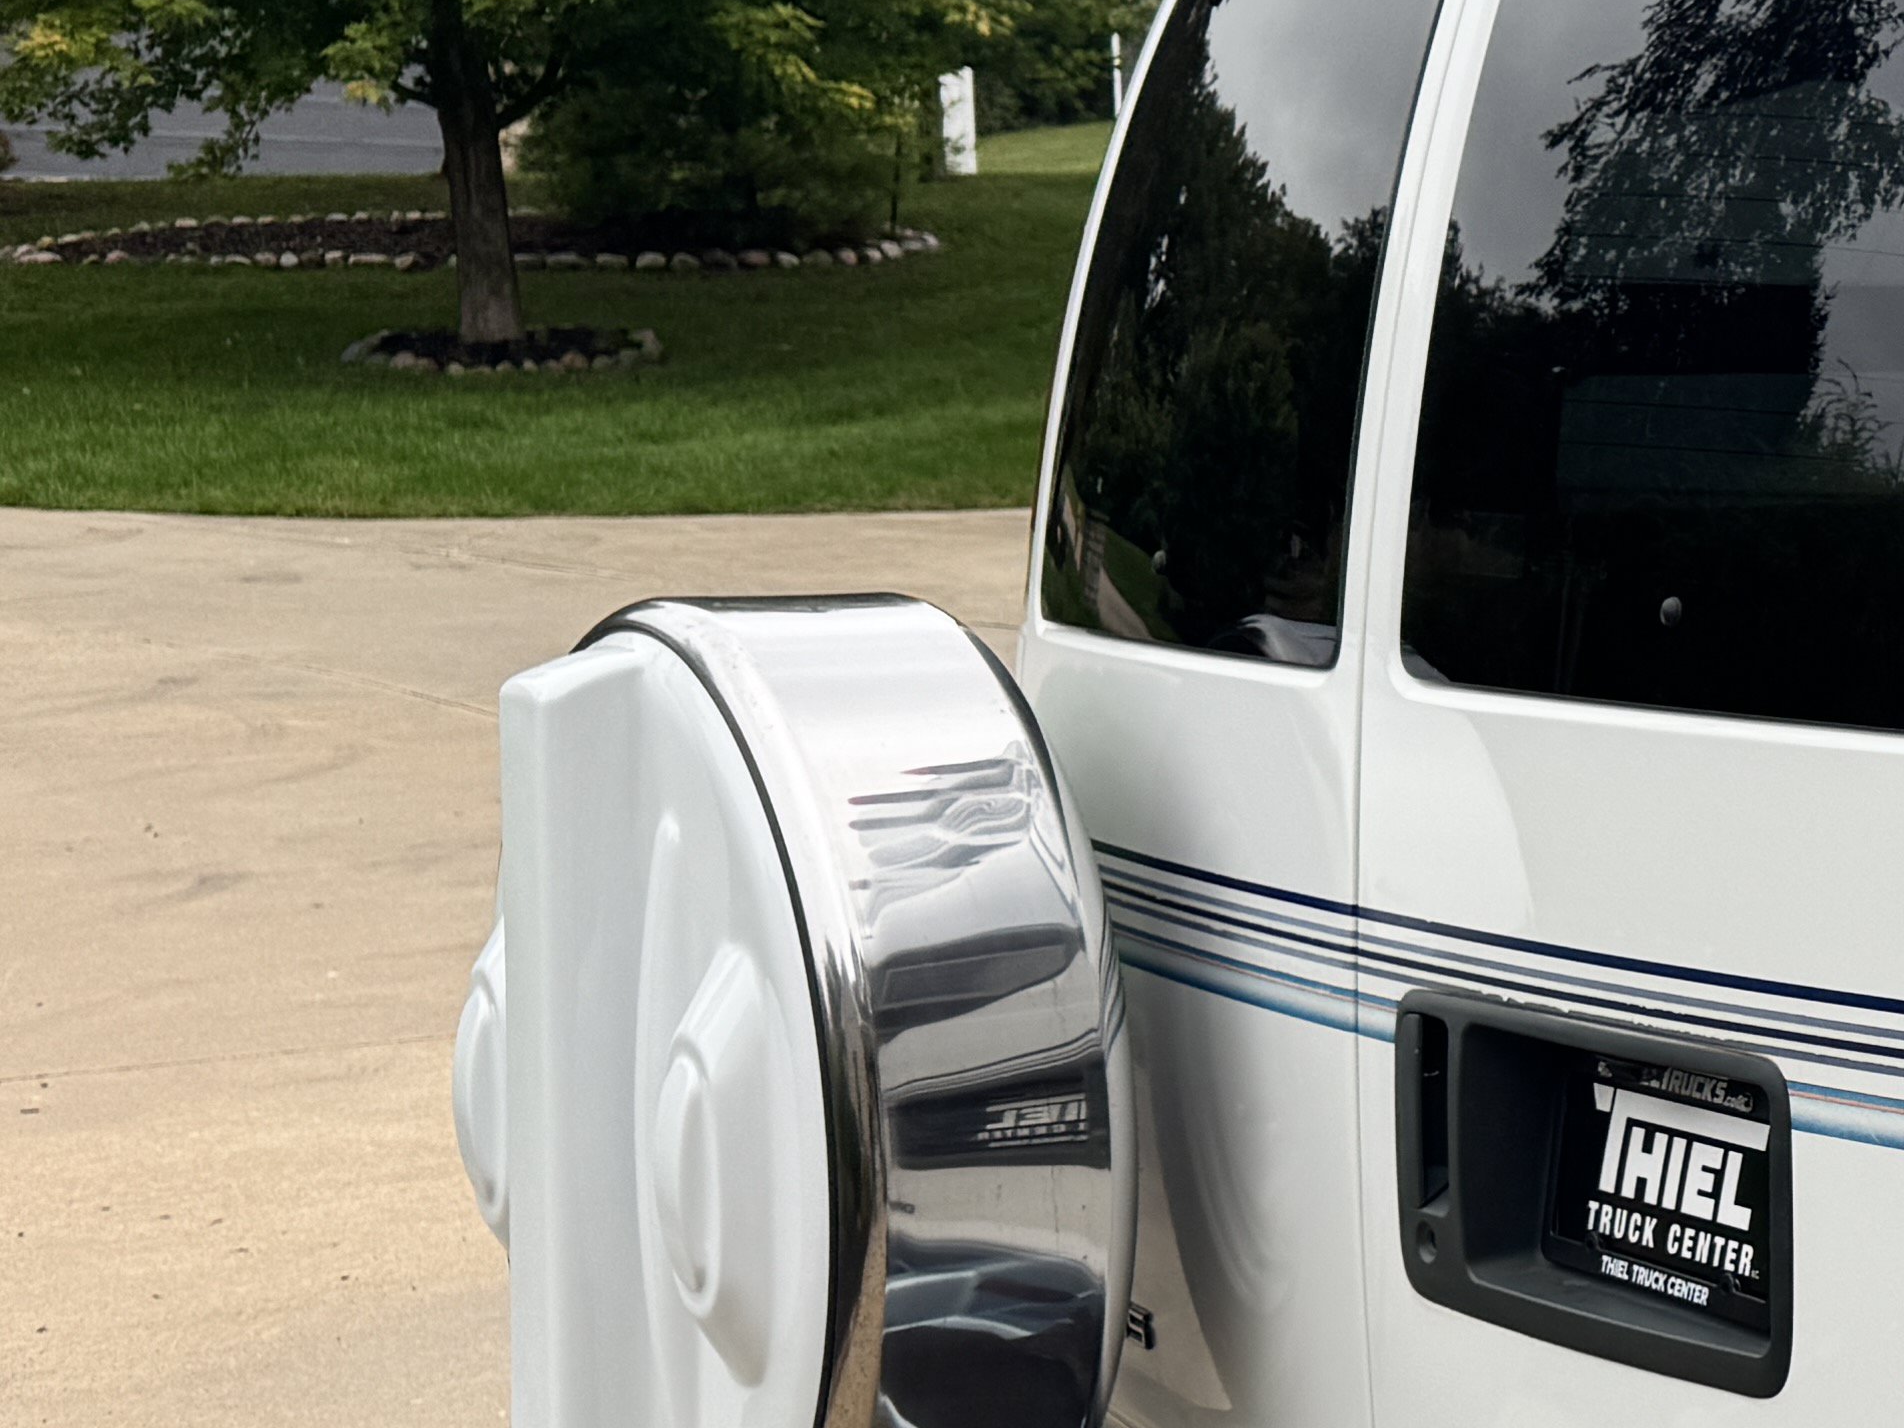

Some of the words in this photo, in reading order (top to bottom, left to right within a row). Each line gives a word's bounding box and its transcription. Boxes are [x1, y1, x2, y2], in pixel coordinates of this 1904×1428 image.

[1594, 1083, 1770, 1231] THIEL
[1586, 1200, 1658, 1249] TRUCK
[1667, 1223, 1754, 1276] CENTER
[1601, 1255, 1629, 1281] THIEL
[1631, 1260, 1667, 1294] TRUCK
[1667, 1275, 1710, 1306] CENTER
